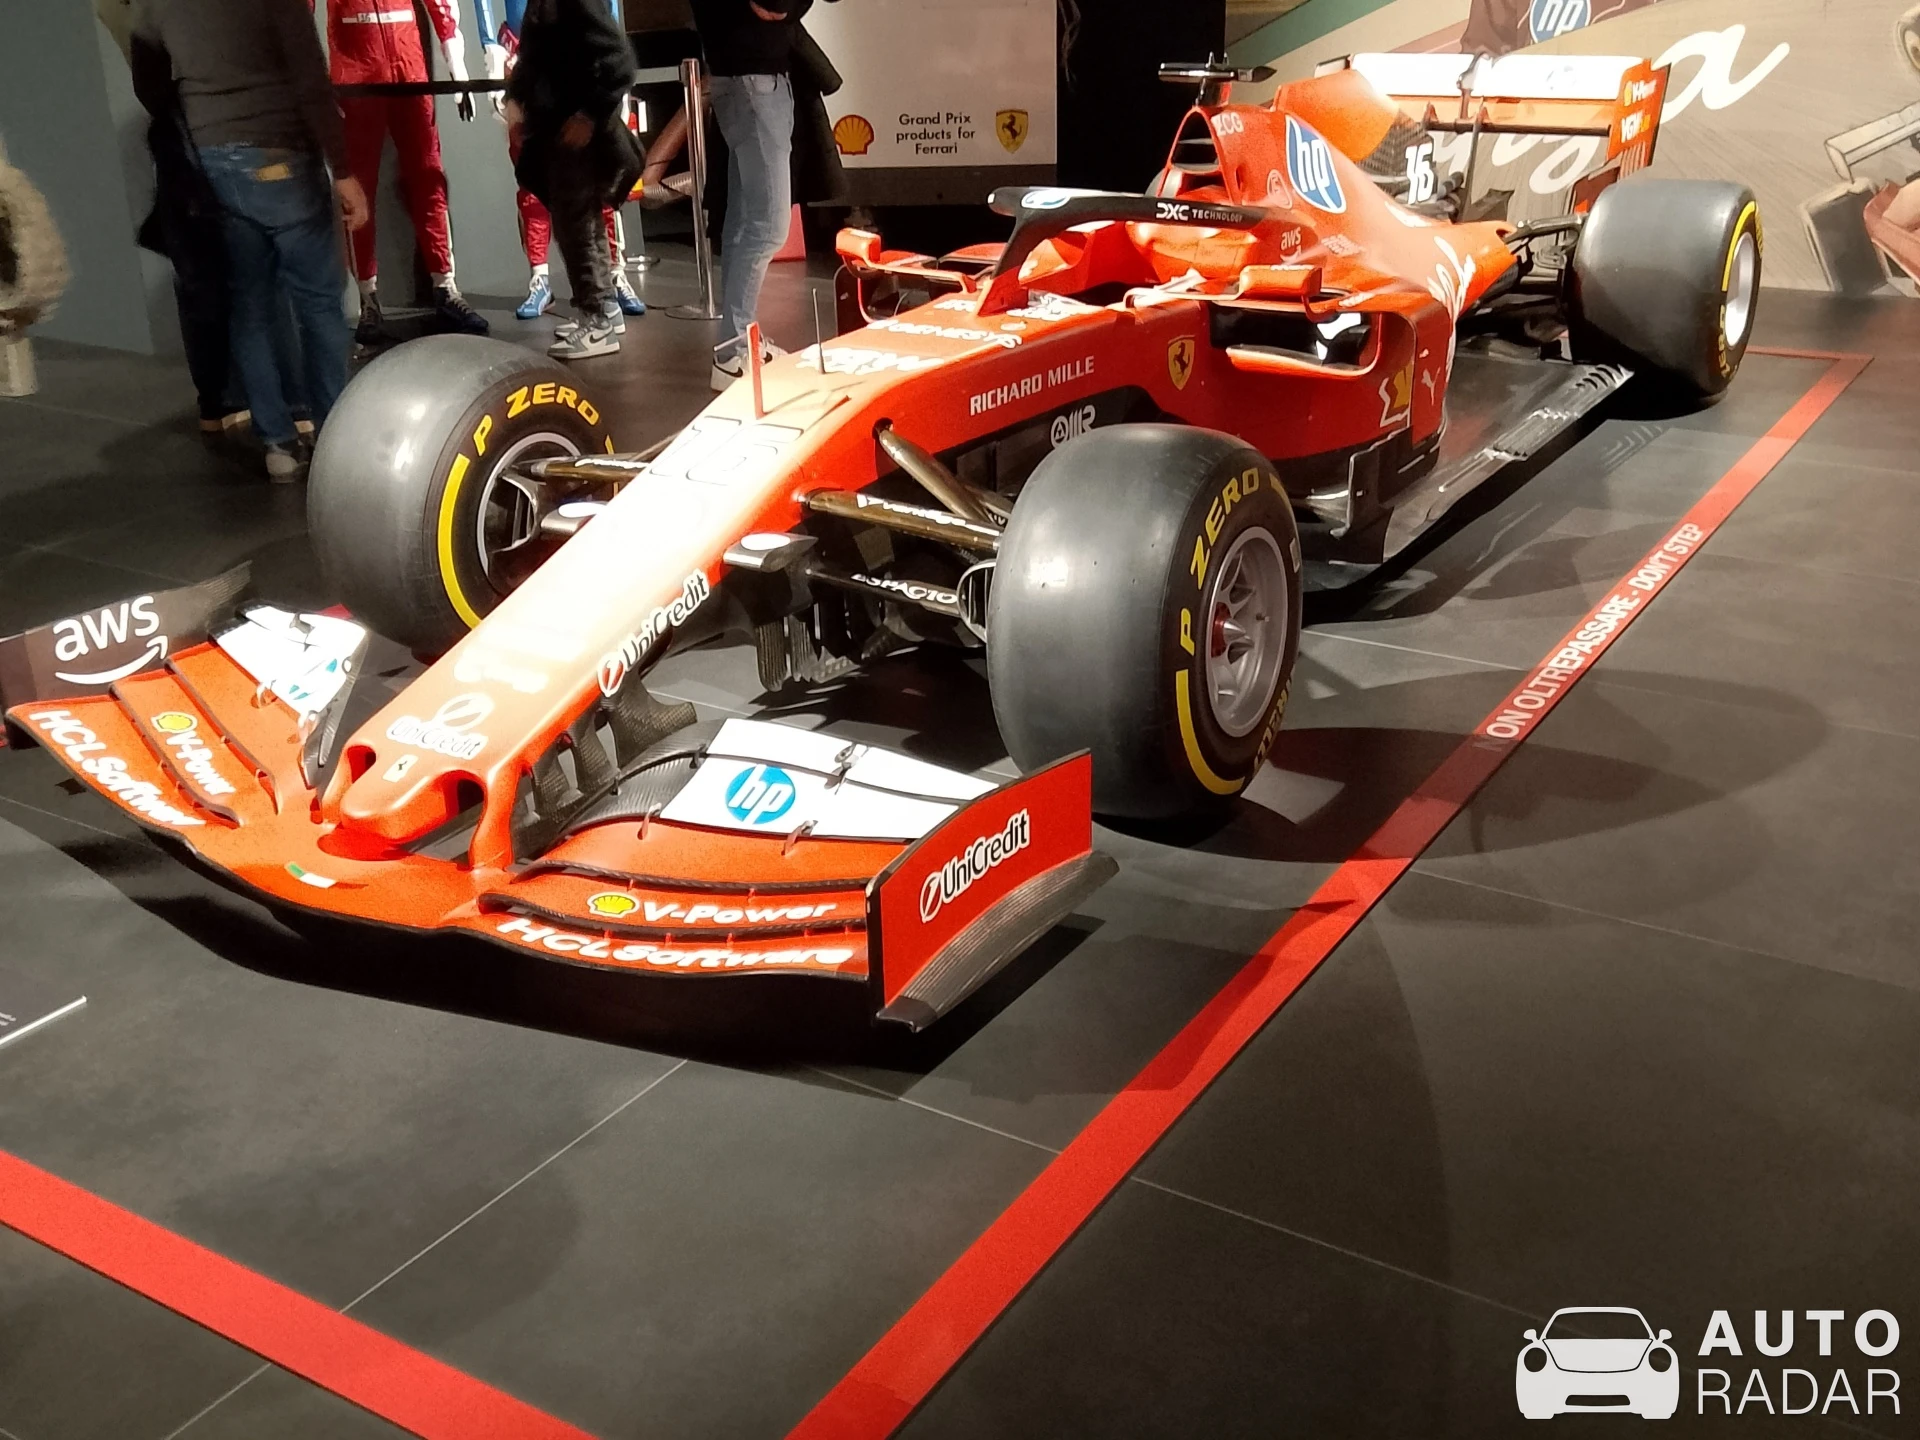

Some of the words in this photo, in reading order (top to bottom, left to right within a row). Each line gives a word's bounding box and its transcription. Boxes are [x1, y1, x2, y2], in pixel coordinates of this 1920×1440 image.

[896, 127, 952, 144] products
[957, 126, 976, 140] for
[898, 112, 941, 126] Grand
[945, 111, 971, 125] Prix
[915, 142, 958, 155] Ferrari
[1288, 114, 1342, 213] hp
[1405, 143, 1434, 205] 16
[1155, 202, 1190, 221] DXC
[1191, 208, 1243, 223] TECHNOLOGY
[1280, 226, 1302, 250] aws
[970, 373, 1042, 417] RICHARD
[1047, 355, 1095, 388] MILLE
[473, 414, 493, 457] P
[506, 381, 600, 426] ZERO
[1180, 607, 1196, 656] P
[1190, 467, 1261, 590] ZERO
[52, 595, 160, 662] aws
[619, 569, 709, 671] UniCredit
[1472, 708, 1534, 752] NON
[1512, 594, 1641, 710] OLTREPASSARE
[1663, 523, 1703, 555] STEP
[726, 762, 795, 825] hp
[941, 808, 1030, 902] UniCredit
[642, 901, 837, 925] V-Power
